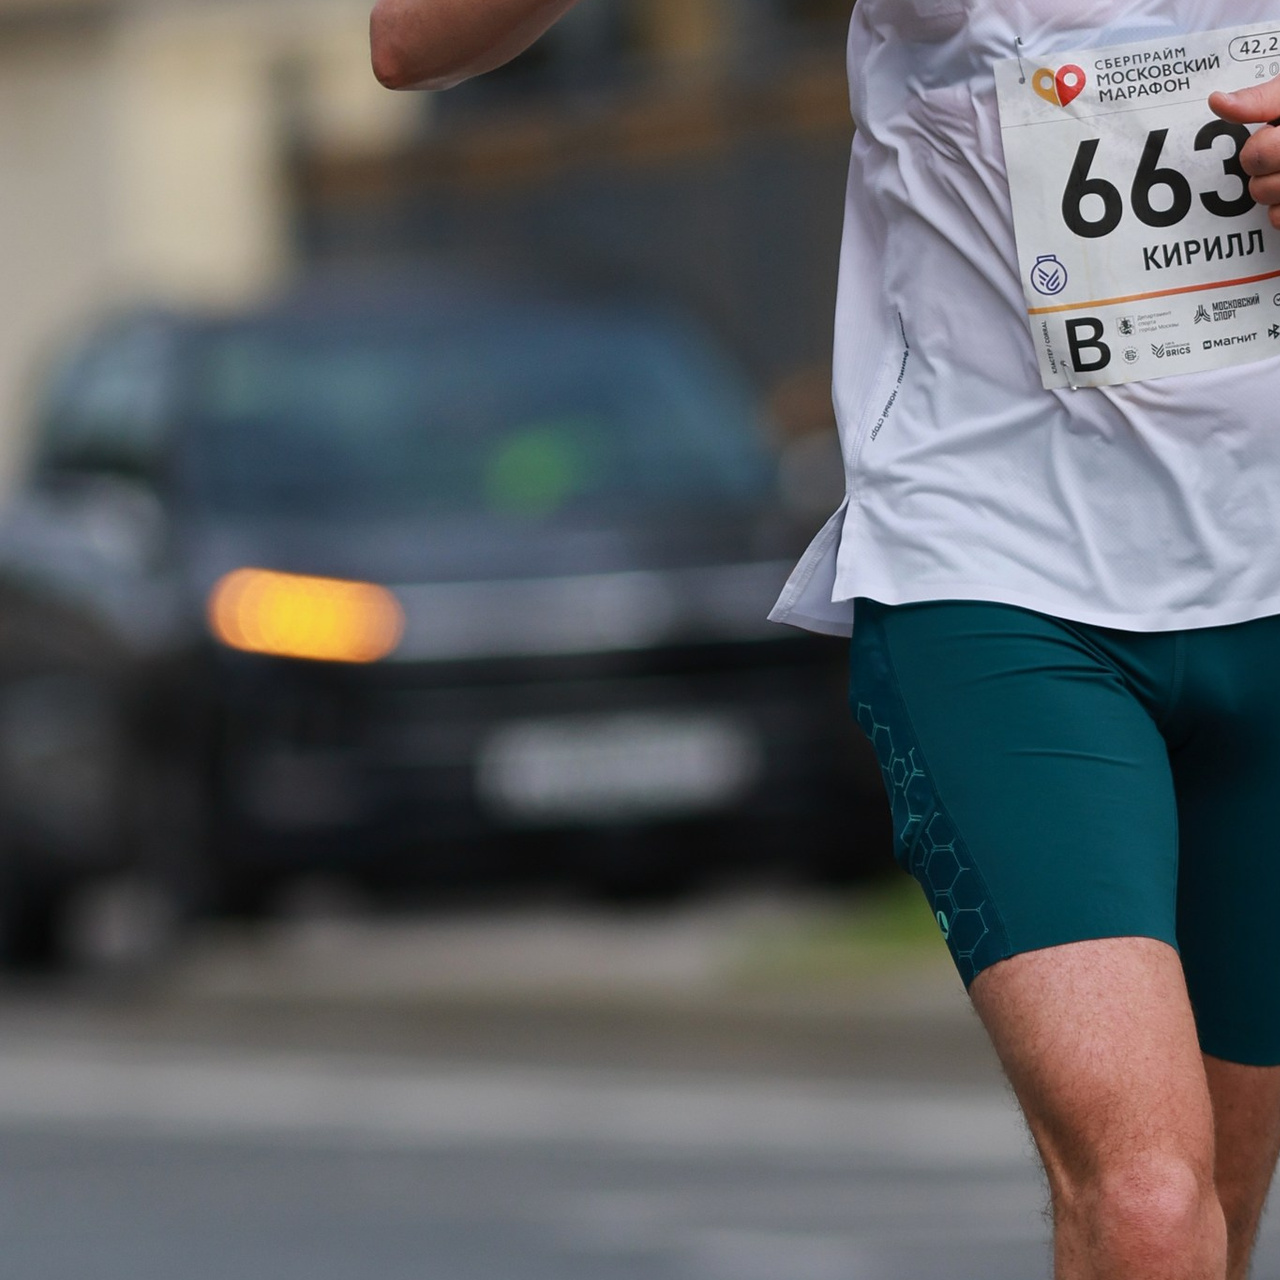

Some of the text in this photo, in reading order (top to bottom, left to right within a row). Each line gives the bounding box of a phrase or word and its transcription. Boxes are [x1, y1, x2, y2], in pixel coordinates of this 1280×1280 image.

[1239, 36, 1278, 56] 42,2
[1094, 47, 1186, 70] СБЕРПРАЙМ
[1096, 54, 1221, 86] МОСКОВСКИЙ
[1099, 77, 1191, 102] МАРАФОН
[1142, 228, 1265, 271] КИРИЛЛ
[1212, 293, 1260, 311] МОСКОВСКИЙ
[1213, 309, 1236, 322] СПОРТ
[1041, 320, 1050, 344] CORRAL
[1047, 348, 1057, 374] КЛАСТЕР
[1166, 346, 1191, 358] BRICS
[881, 390, 898, 418] новый
[869, 417, 885, 442] старт
